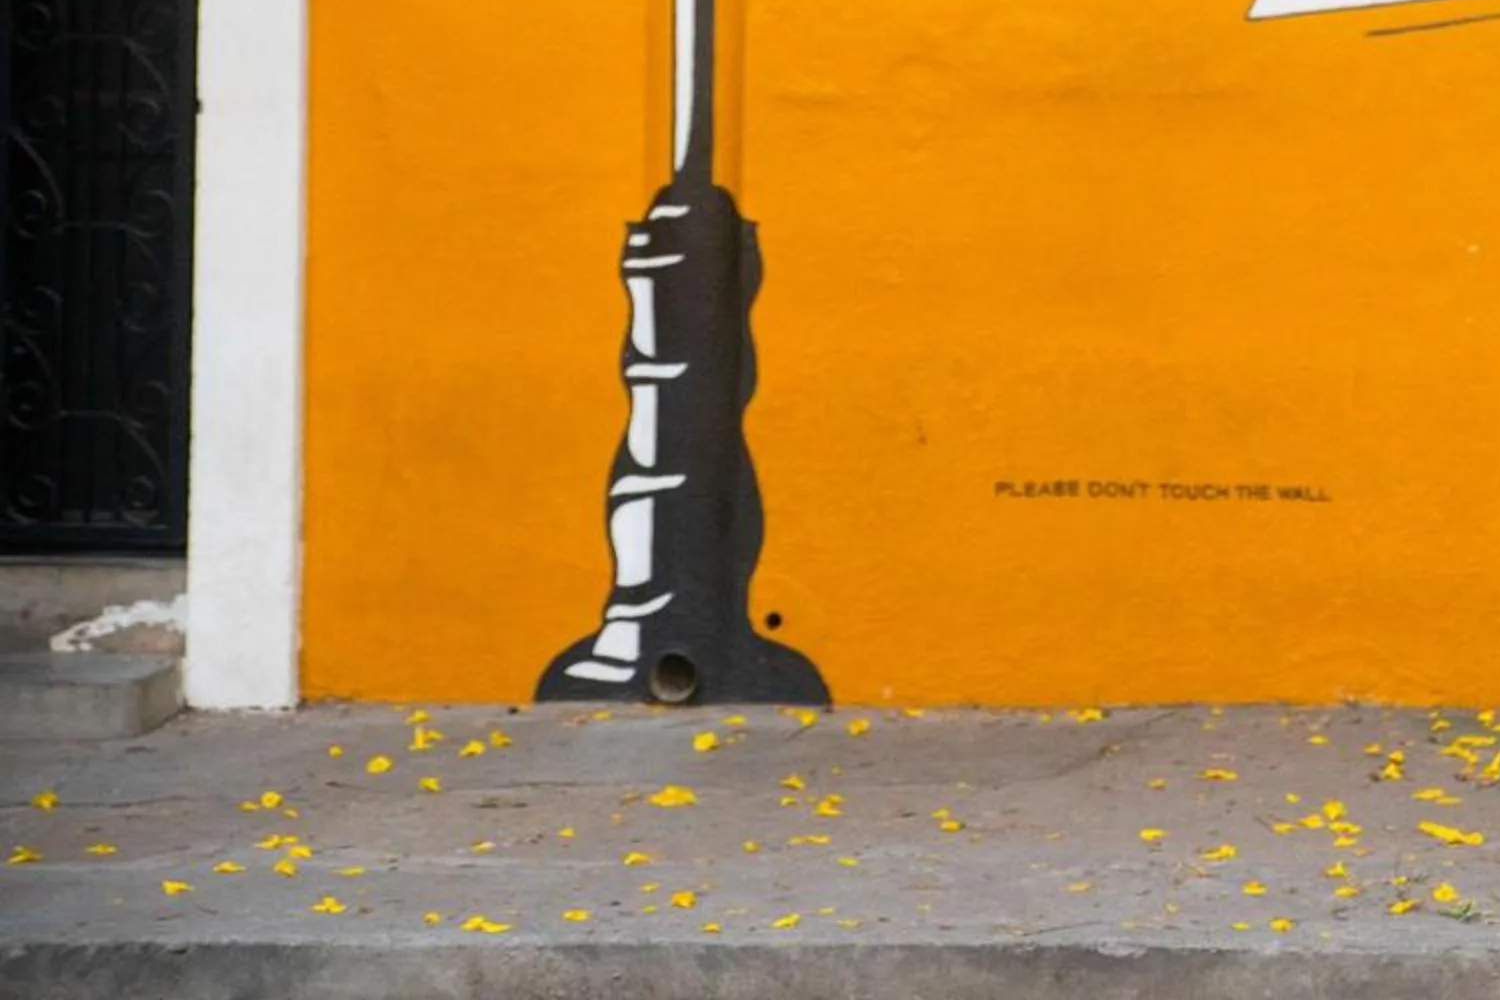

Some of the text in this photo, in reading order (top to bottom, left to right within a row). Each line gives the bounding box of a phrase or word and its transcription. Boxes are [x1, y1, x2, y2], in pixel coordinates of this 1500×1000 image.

[994, 480, 1080, 498] PLEASE
[1158, 482, 1229, 501] TOUCH
[1235, 484, 1272, 501] THE
[1277, 486, 1332, 502] WALL
